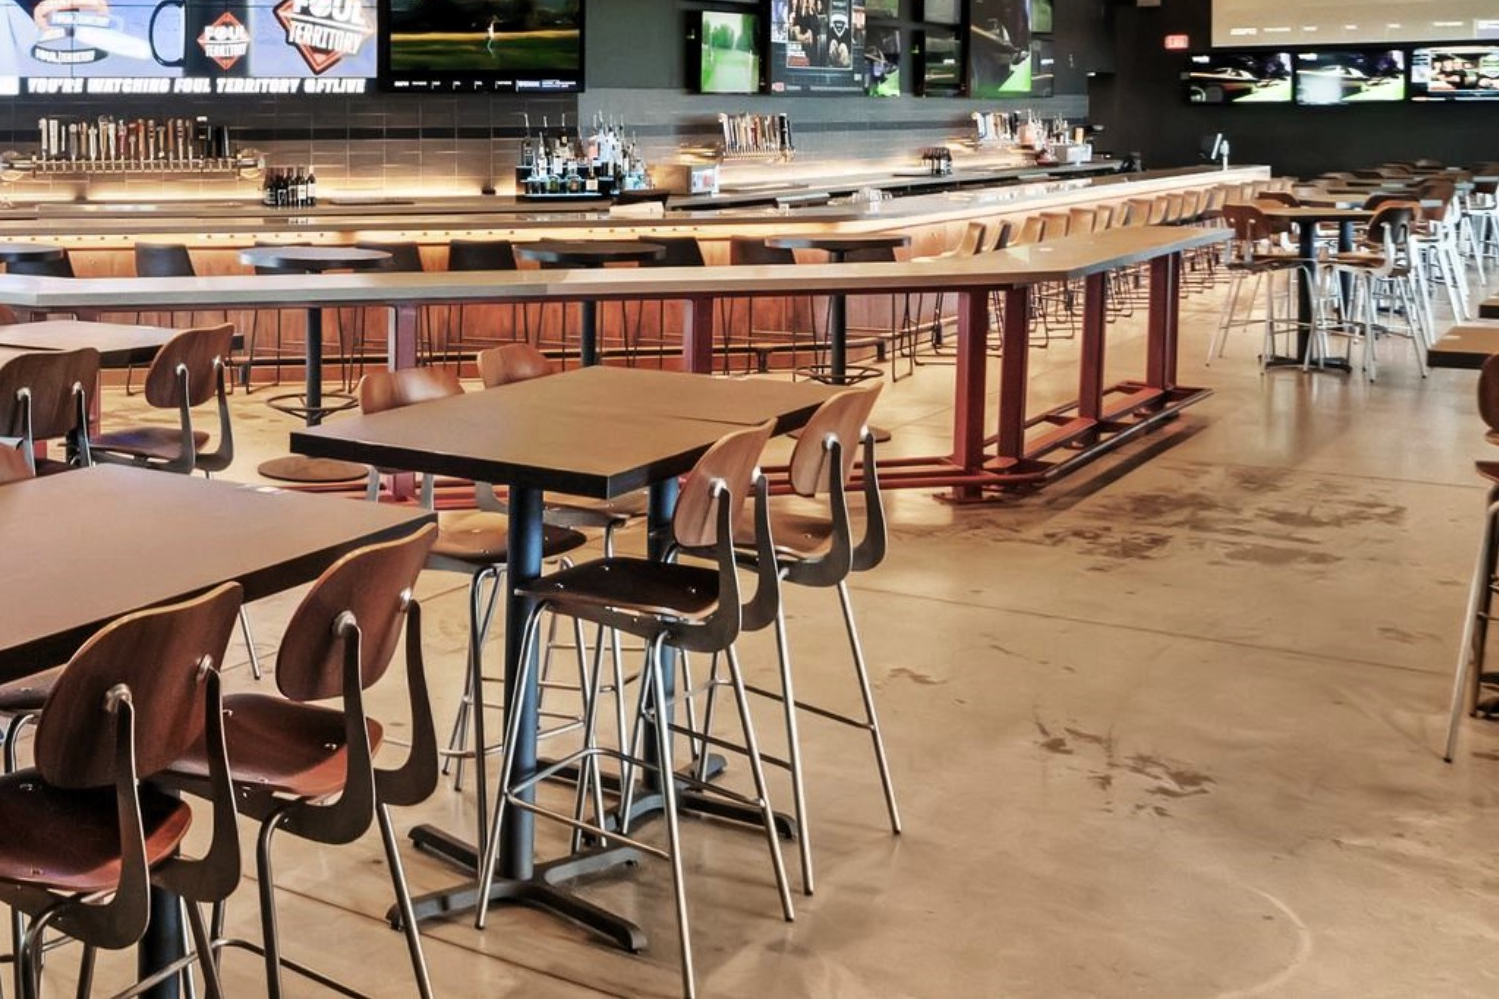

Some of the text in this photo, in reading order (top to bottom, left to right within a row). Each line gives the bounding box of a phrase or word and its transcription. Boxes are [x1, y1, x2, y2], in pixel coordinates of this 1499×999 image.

[204, 25, 248, 42] FOUL
[288, 21, 364, 55] TERRITORY
[27, 77, 84, 94] YOU'RE
[86, 77, 171, 94] WATCHING
[174, 77, 212, 94] FOUL
[216, 77, 301, 94] TERRITORY
